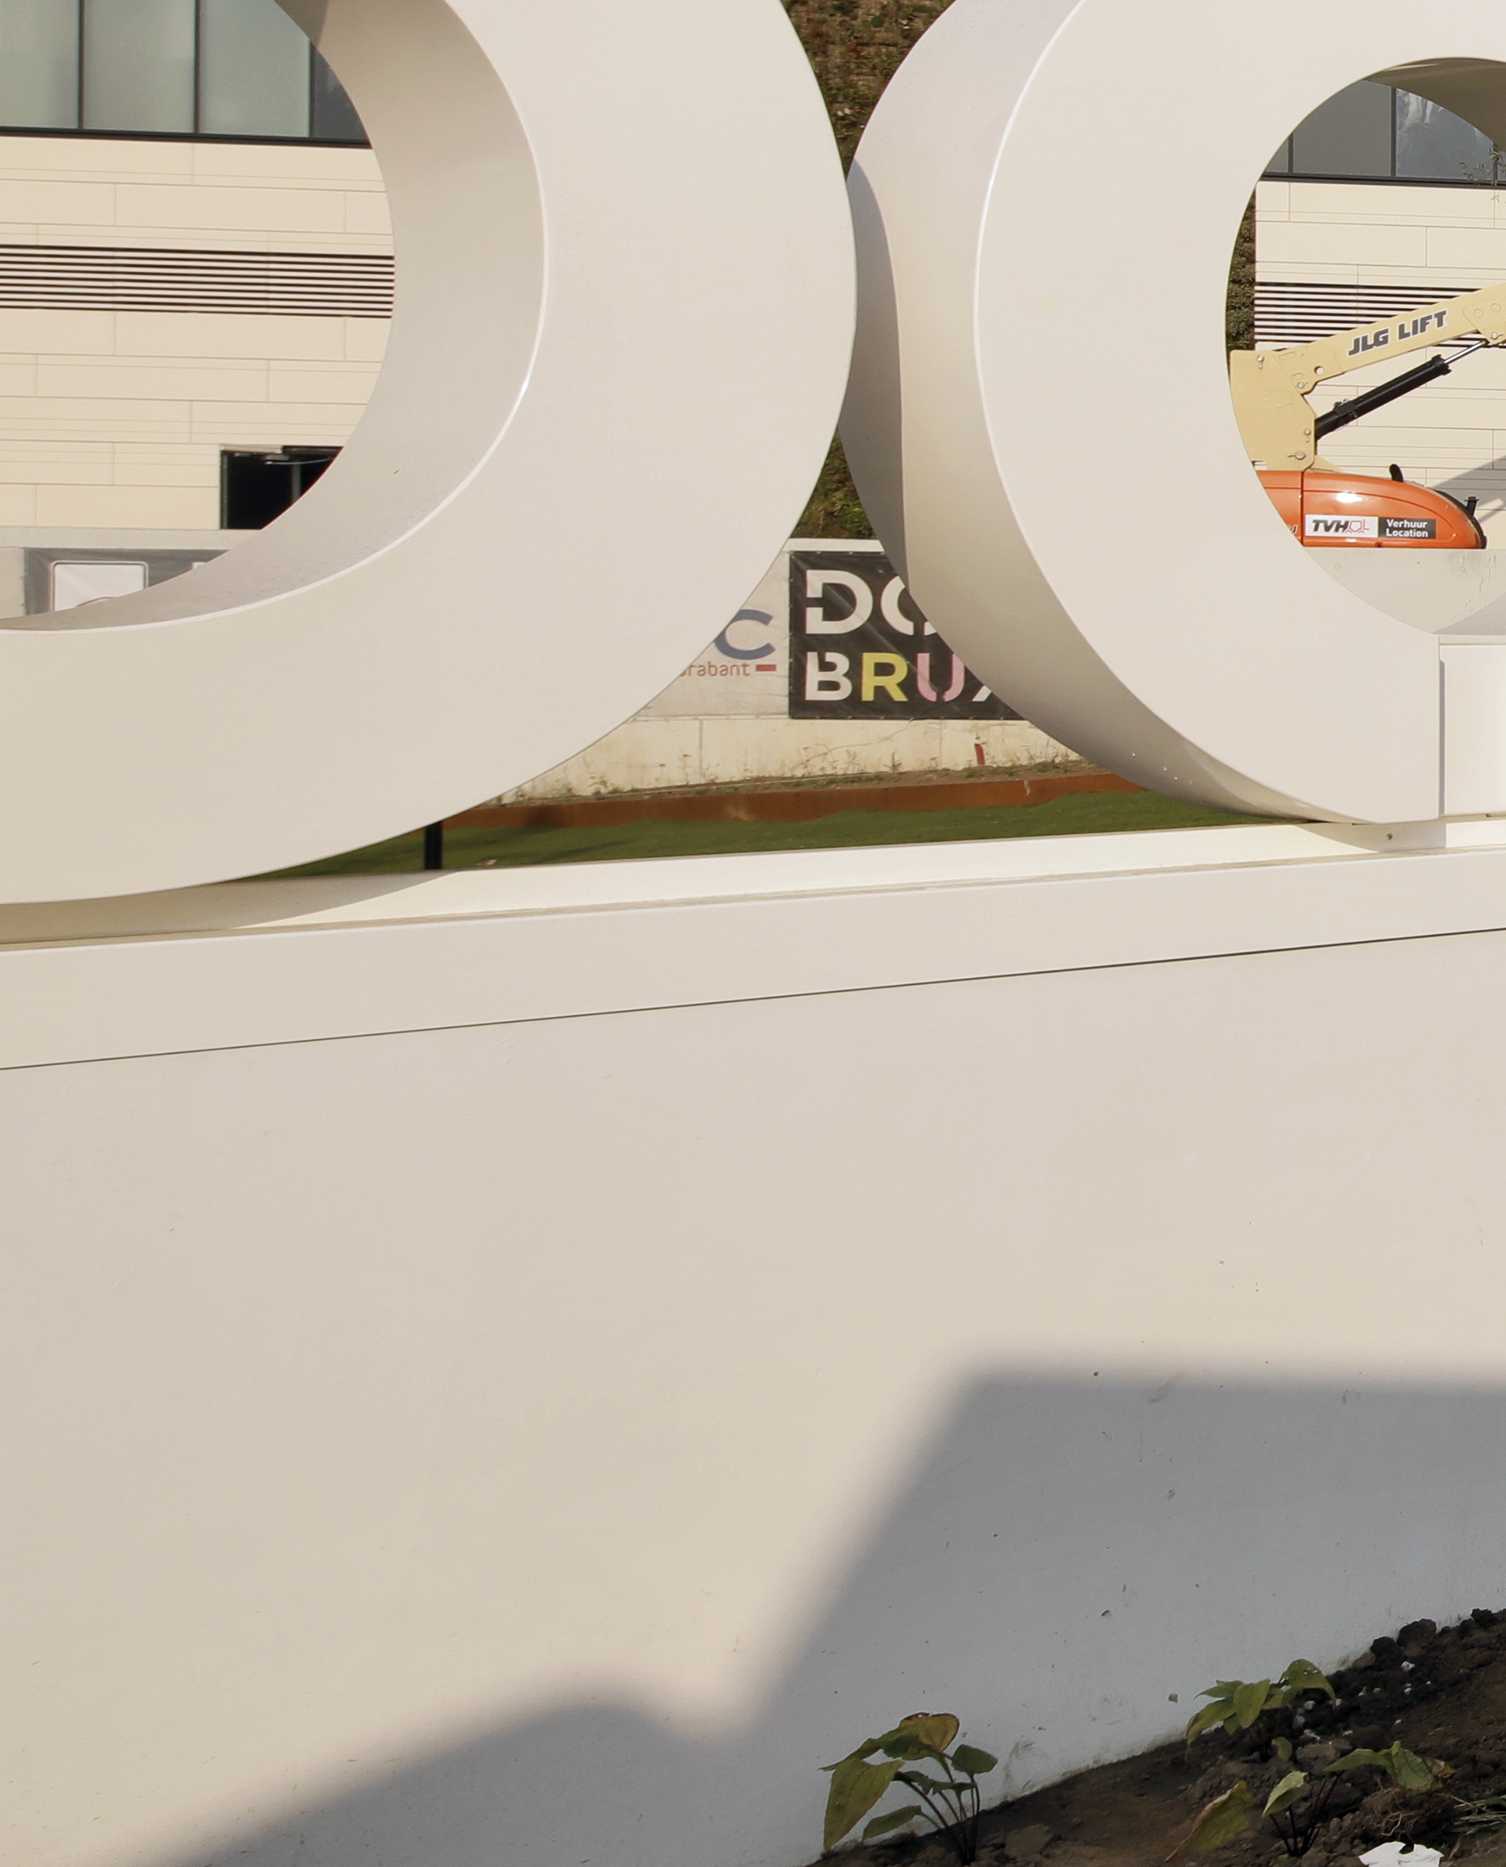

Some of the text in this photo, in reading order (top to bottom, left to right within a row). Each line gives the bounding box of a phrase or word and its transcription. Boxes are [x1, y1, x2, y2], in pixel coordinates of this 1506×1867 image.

[1348, 310, 1447, 356] JLG LIFT
[1312, 519, 1349, 532] TVH
[1386, 519, 1429, 529] Verhuur
[1386, 528, 1429, 538] Location
[680, 661, 751, 677] rabant
